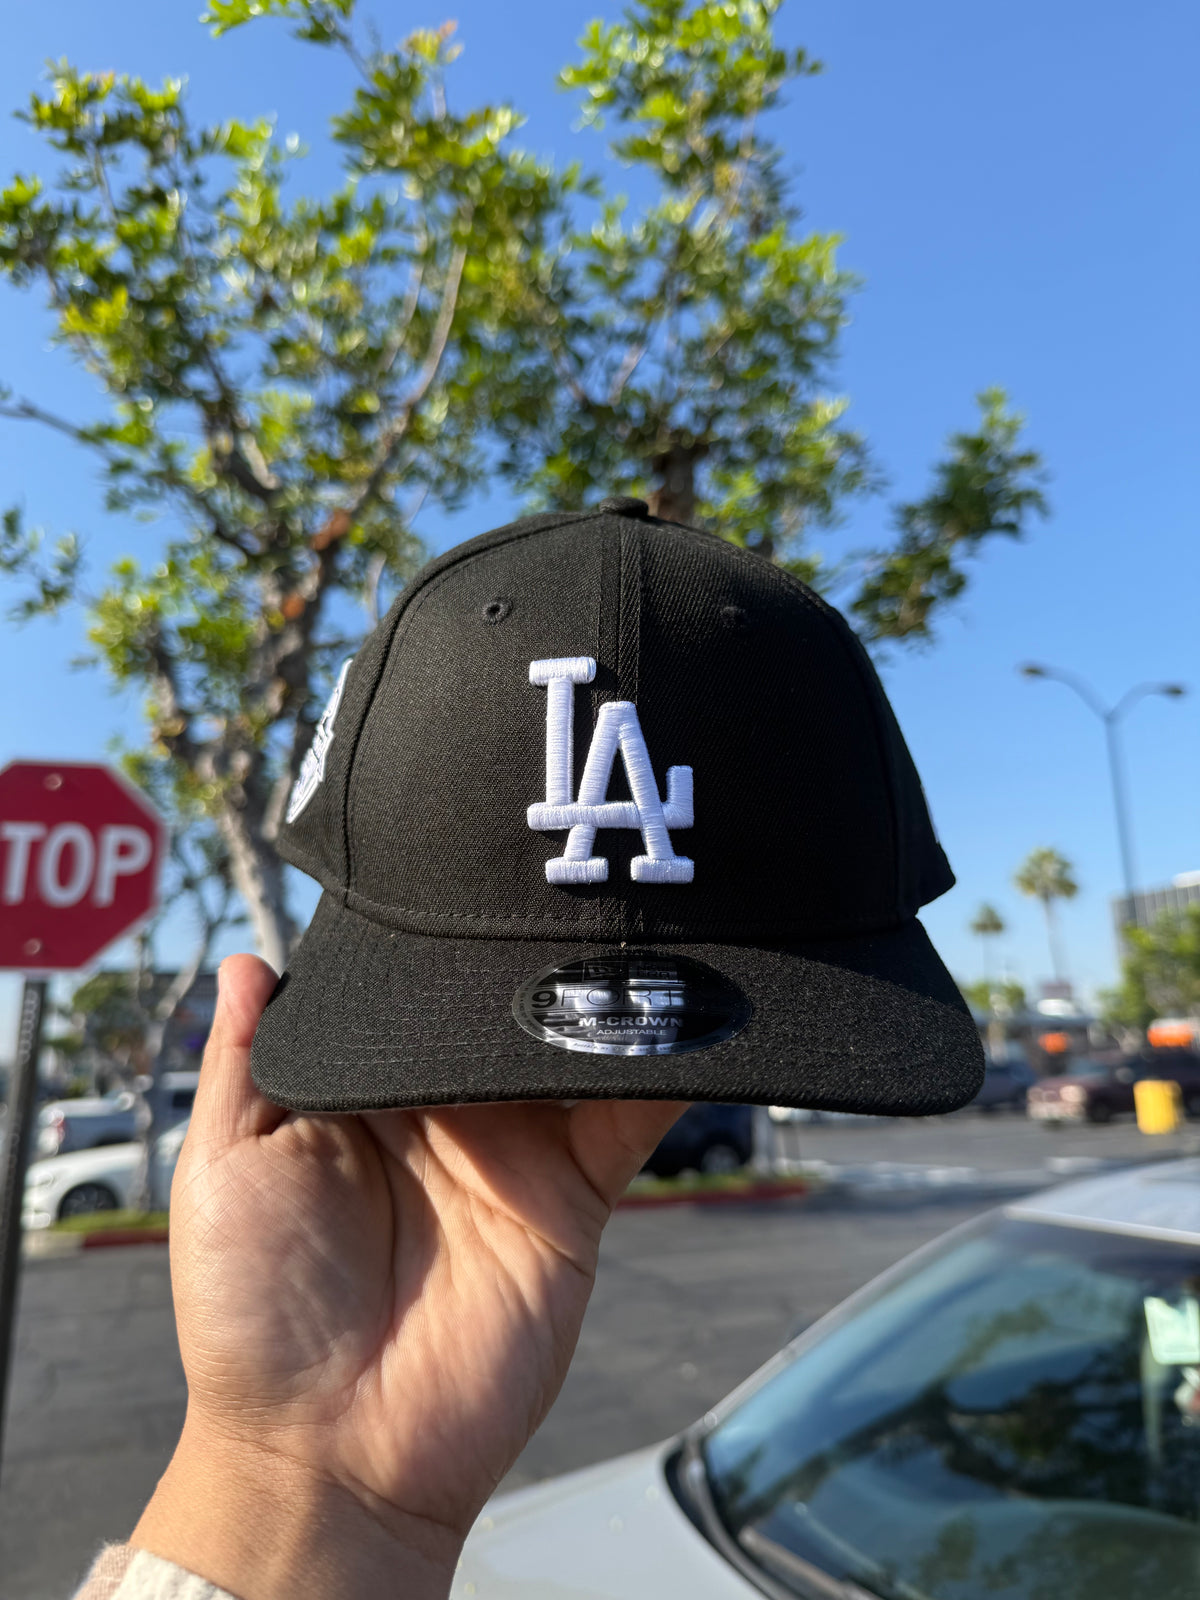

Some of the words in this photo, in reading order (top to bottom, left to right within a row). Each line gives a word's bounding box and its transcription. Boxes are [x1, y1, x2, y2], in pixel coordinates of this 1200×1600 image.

[527, 656, 694, 884] LA
[0, 821, 152, 908] TOP
[531, 987, 718, 1009] 9FORT
[580, 1016, 684, 1028] M-CROWN
